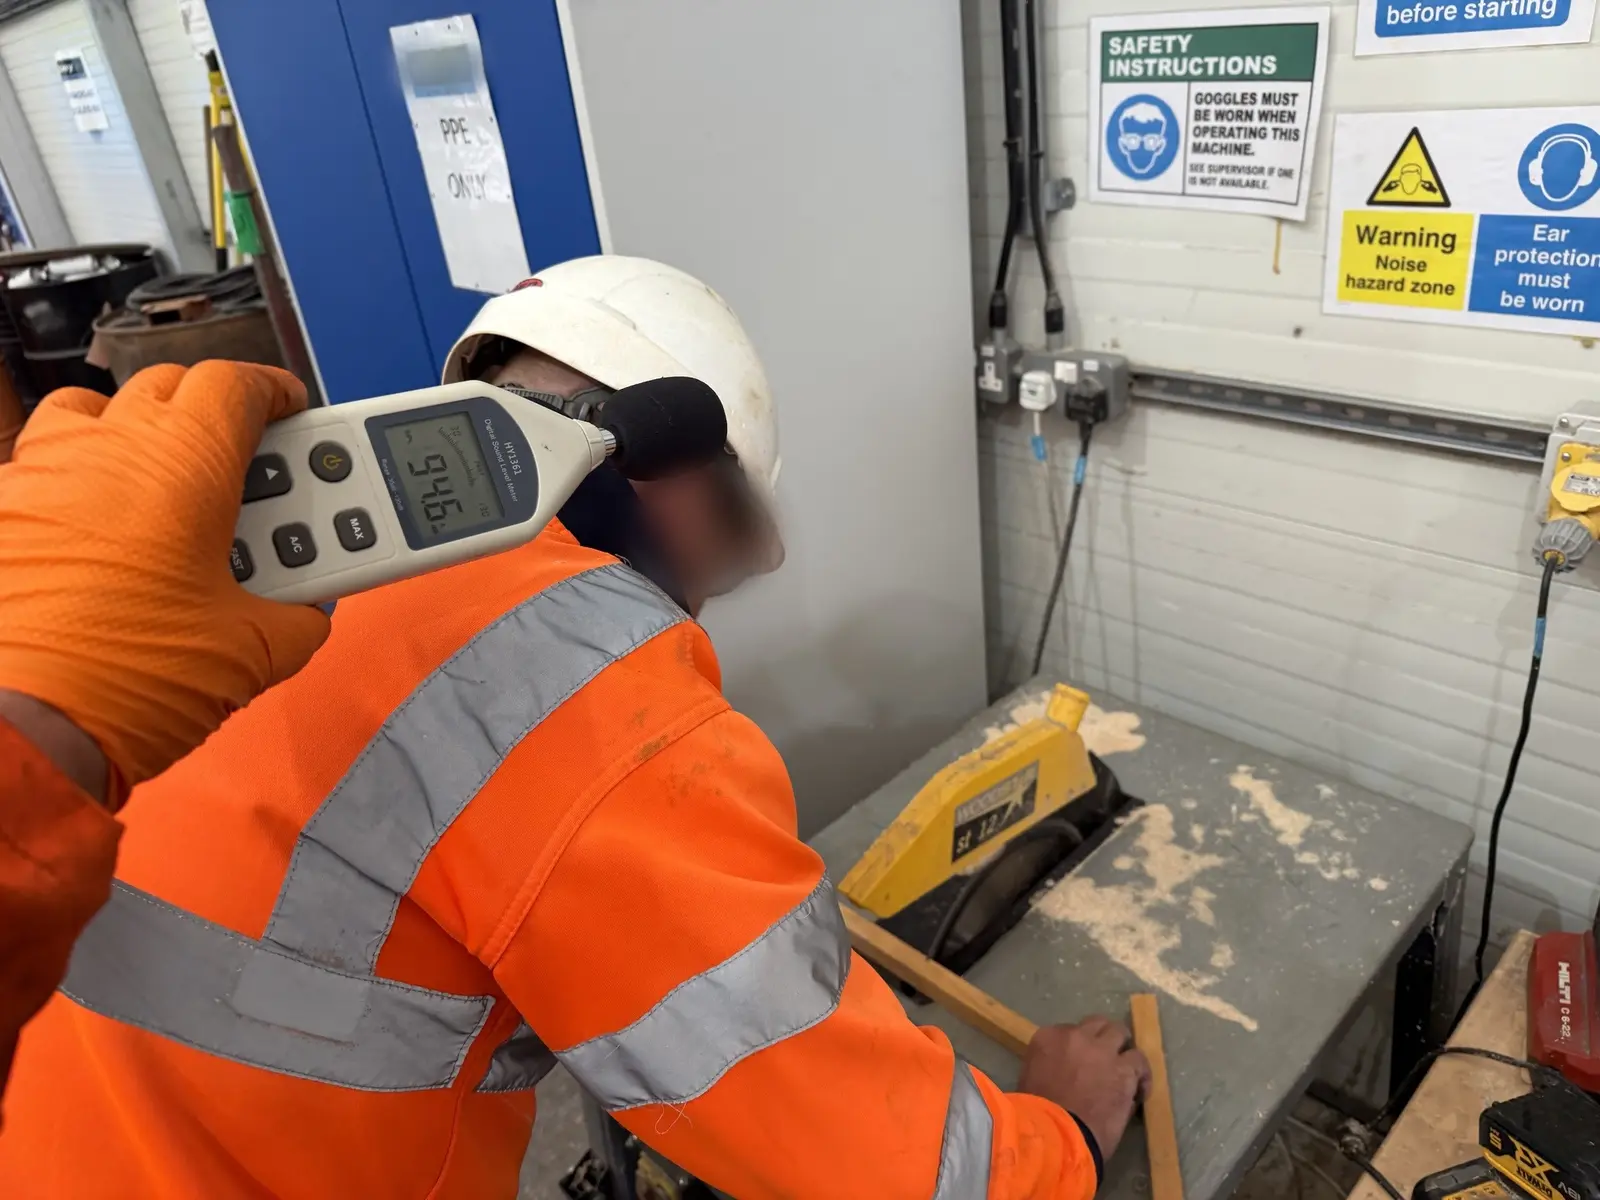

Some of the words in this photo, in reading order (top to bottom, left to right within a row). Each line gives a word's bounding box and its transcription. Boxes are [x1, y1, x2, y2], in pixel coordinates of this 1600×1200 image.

[1386, 3, 1458, 26] before
[1464, 0, 1557, 20] starting
[1108, 34, 1193, 55] SAFETY
[1108, 55, 1278, 77] INSTRUCTIONS
[1194, 92, 1257, 106] GOGGLES
[1261, 92, 1299, 106] MUST
[1194, 109, 1211, 122] BE
[1214, 109, 1254, 123] WORN
[1258, 110, 1297, 124] WHEN
[440, 116, 472, 145] PPE
[1192, 126, 1268, 140] OPERATING
[1271, 127, 1300, 142] THIS
[1191, 142, 1255, 157] MACHINE.
[1188, 162, 1205, 174] SEE
[1207, 163, 1265, 176] SUPERVISOR
[1267, 166, 1276, 177] IF
[1277, 168, 1294, 179] ONE
[1188, 176, 1197, 186] IS
[1199, 176, 1217, 187] NOT
[447, 172, 487, 200] ONLY
[1356, 224, 1457, 255] Warning
[1532, 224, 1571, 243] Ear
[1375, 255, 1428, 272] Noise
[1494, 247, 1600, 268] protection
[1345, 274, 1405, 292] hazard
[1410, 280, 1456, 296] zone
[1518, 272, 1572, 289] must
[1500, 290, 1526, 308] be
[1532, 296, 1585, 314] worn
[484, 418, 498, 441] Digital
[491, 440, 505, 464] Sound
[499, 461, 512, 484] Level
[506, 481, 519, 503] Meter
[503, 441, 523, 476] HY1361
[407, 453, 464, 522] 94.6
[349, 517, 365, 541] MAX
[289, 535, 303, 554] A/C
[231, 547, 245, 571] FAST
[1558, 961, 1572, 1005] HILTI
[1560, 1007, 1571, 1015] C
[1515, 1165, 1554, 1198] DEWALT
